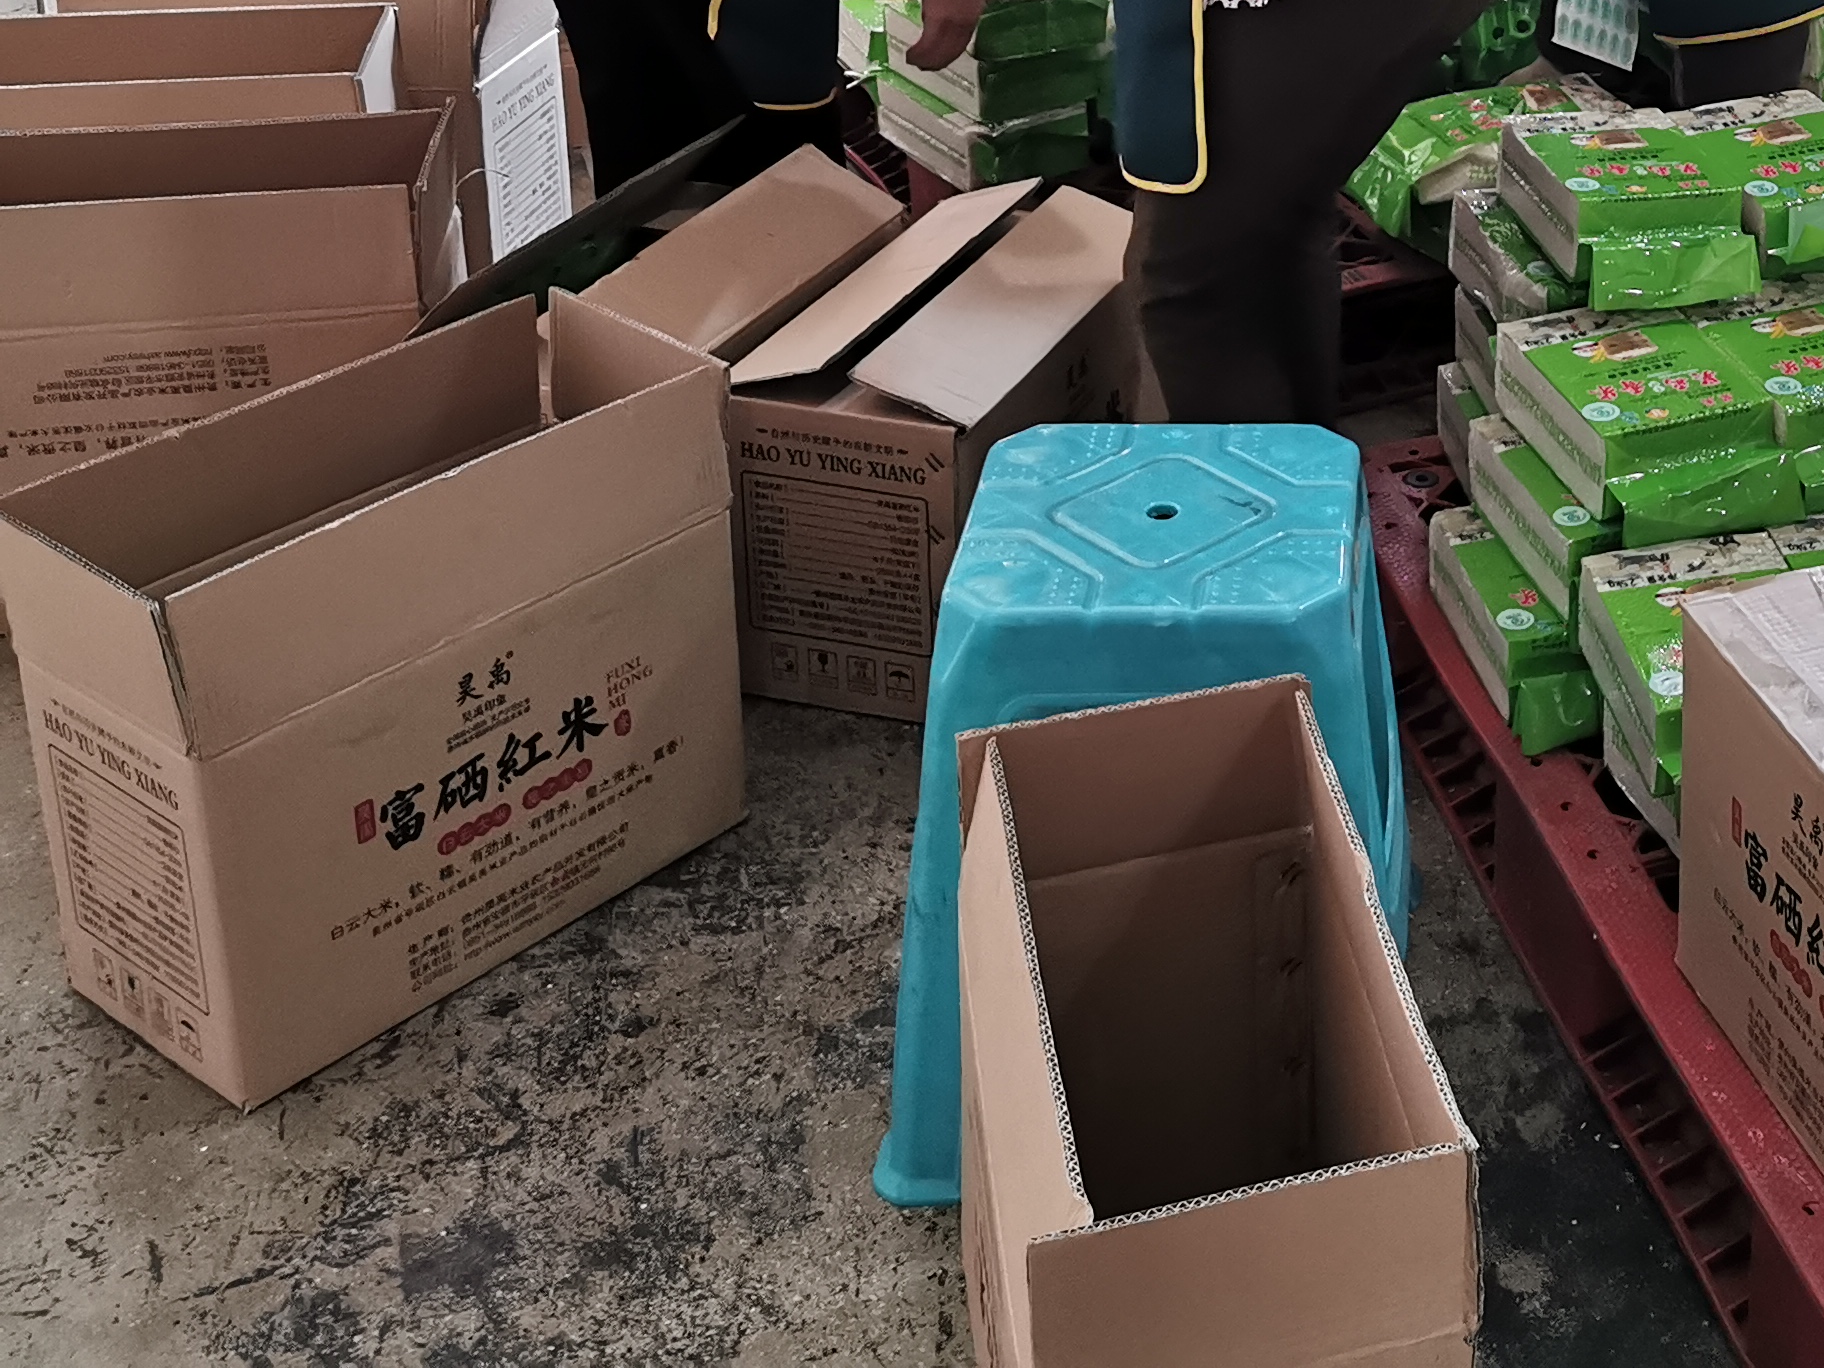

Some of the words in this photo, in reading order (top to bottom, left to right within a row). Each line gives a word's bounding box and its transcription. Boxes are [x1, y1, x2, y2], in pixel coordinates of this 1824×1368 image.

[740, 441, 781, 462] HAO
[785, 446, 811, 468] YU
[816, 452, 862, 476] YING
[868, 460, 927, 485] XIANG
[607, 667, 653, 697] HONG
[43, 709, 73, 743] HAO
[75, 730, 96, 756] YU
[97, 744, 132, 781] YING
[135, 768, 179, 811] XIANG
[379, 695, 609, 850] 富硒紅米
